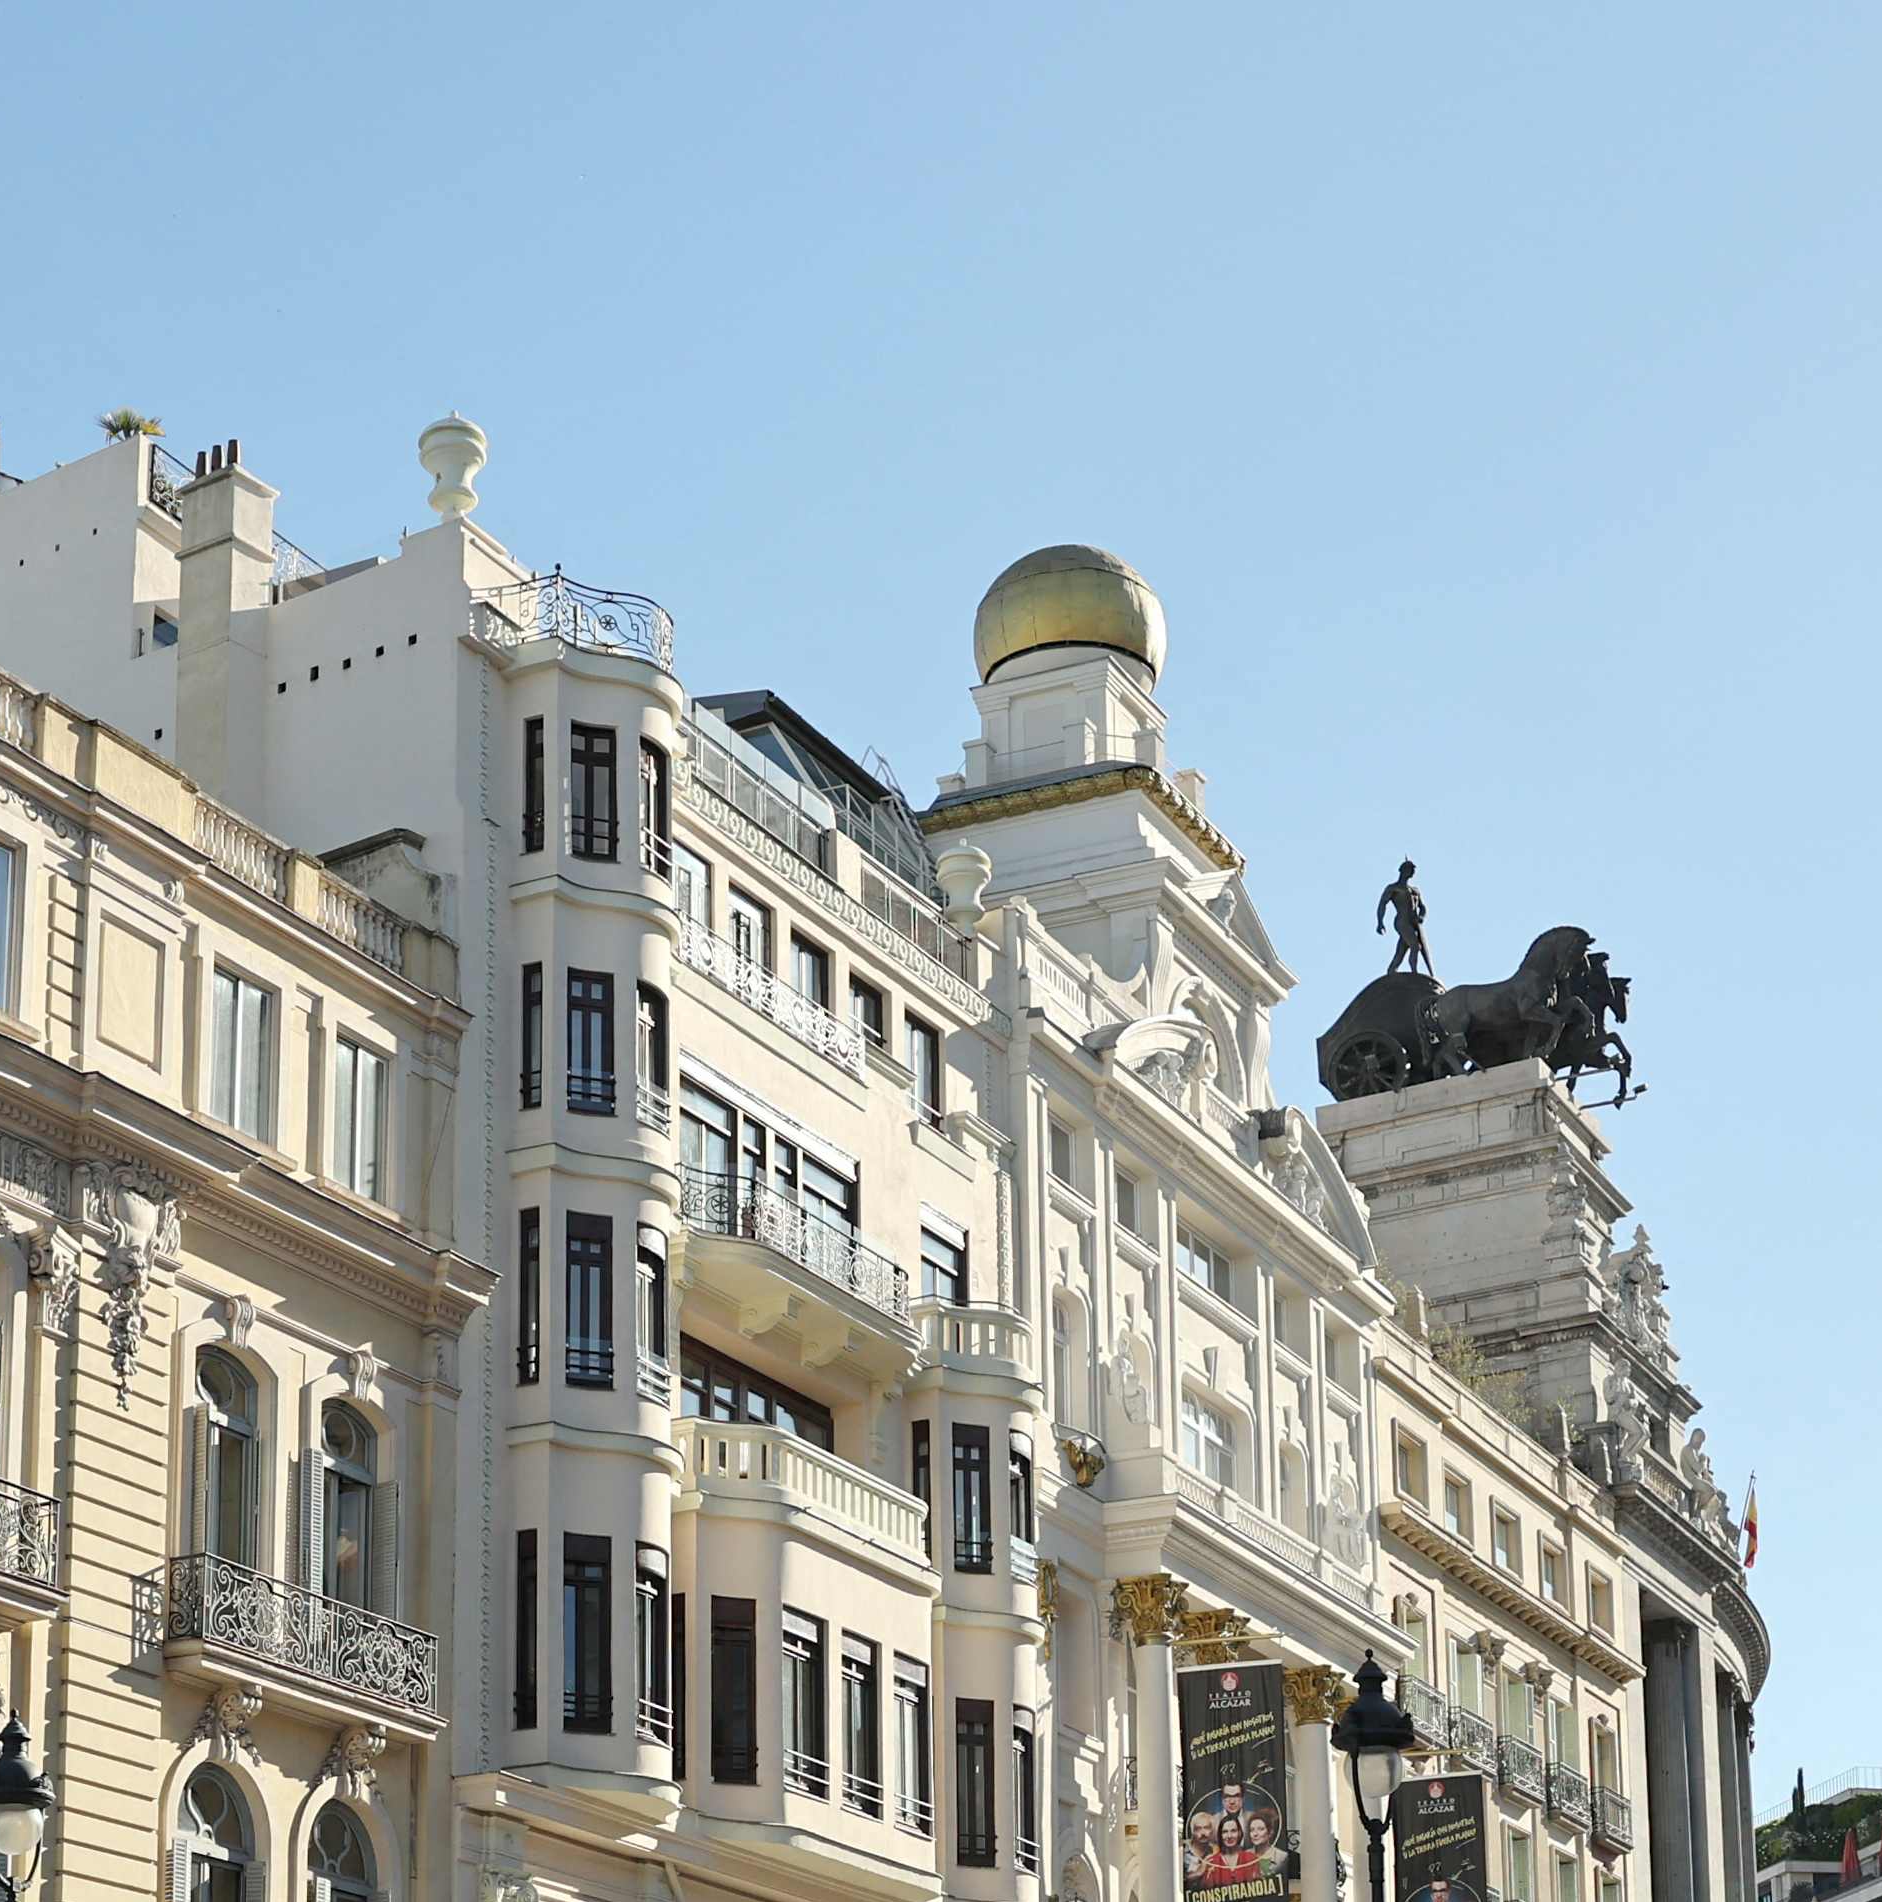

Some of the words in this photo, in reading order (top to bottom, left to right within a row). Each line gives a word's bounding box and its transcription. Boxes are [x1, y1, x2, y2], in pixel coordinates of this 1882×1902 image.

[1209, 1690, 1252, 1699] TEATRO
[1197, 1746, 1206, 1757] LA
[1206, 1740, 1229, 1755] TIERRA
[1229, 1732, 1251, 1748] FUERA
[1415, 1840, 1436, 1855] TIERRA
[1436, 1834, 1455, 1849] FUERA
